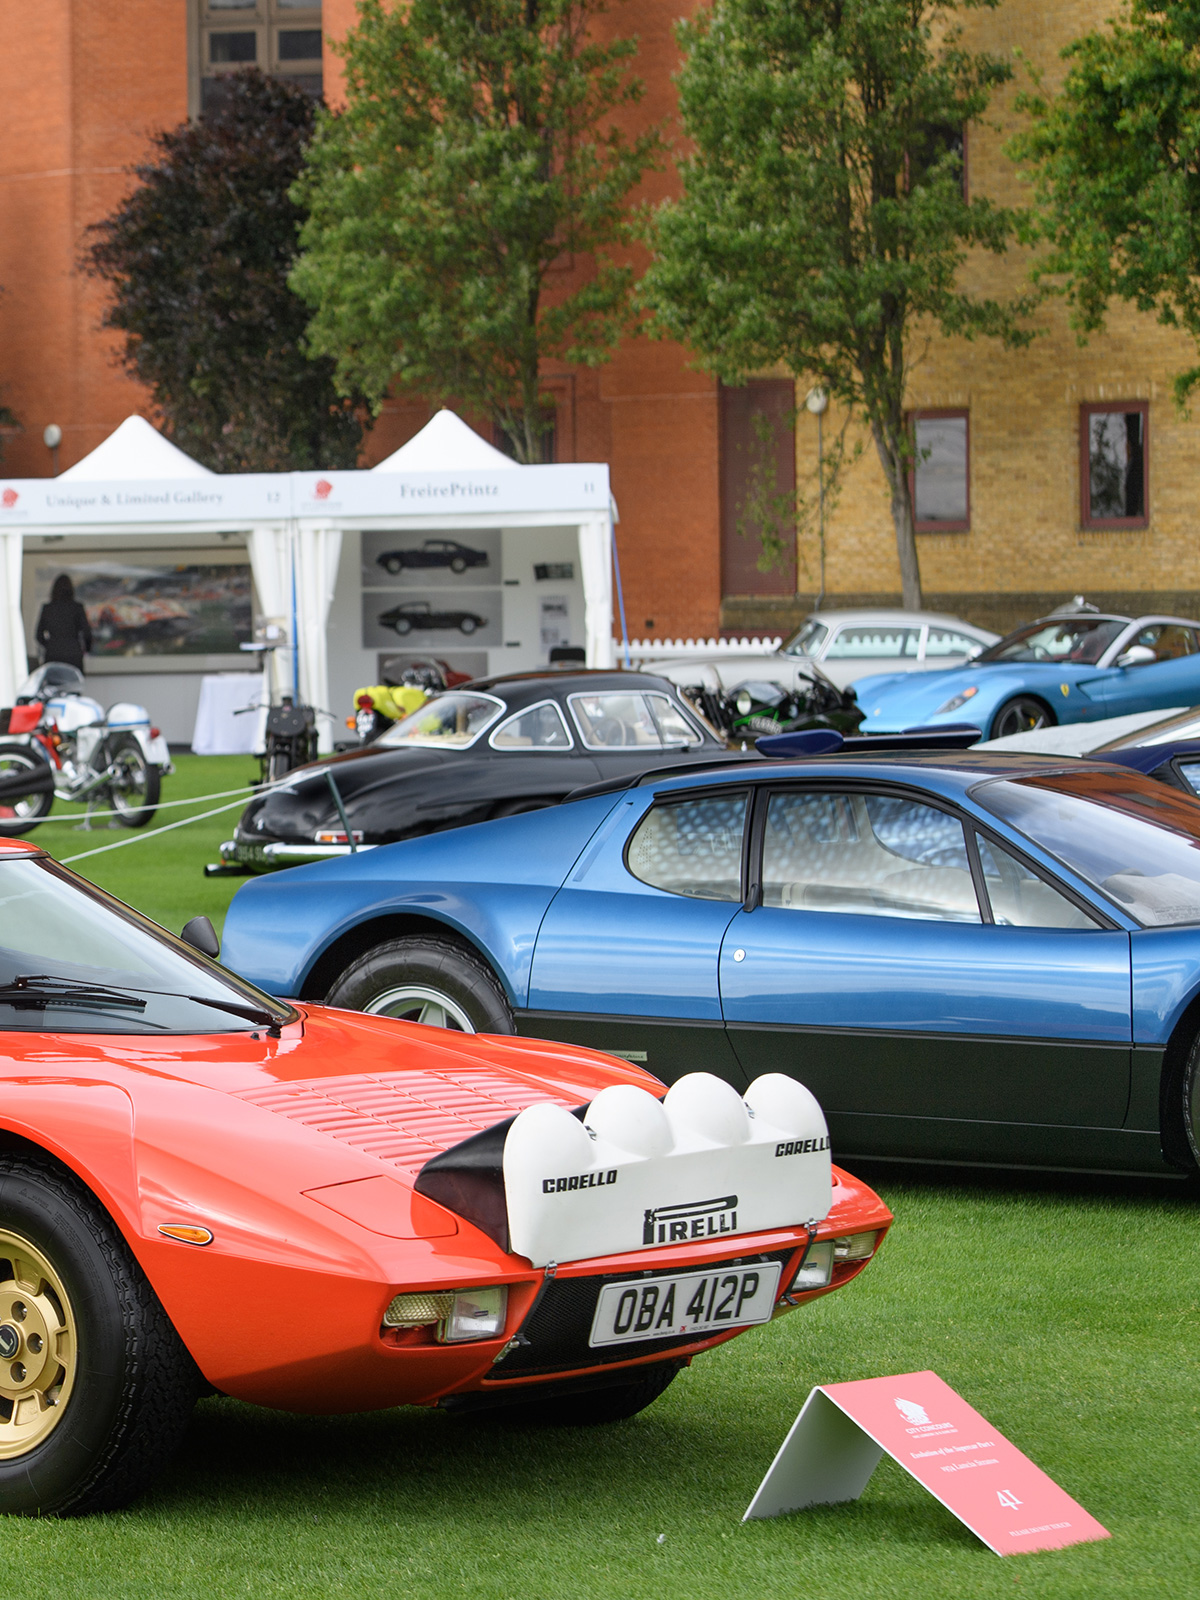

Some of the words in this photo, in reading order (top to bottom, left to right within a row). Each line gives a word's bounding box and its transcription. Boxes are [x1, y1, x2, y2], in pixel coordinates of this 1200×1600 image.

[46, 494, 96, 509] Unique
[116, 491, 170, 506] Limited
[173, 490, 223, 506] Gallery
[400, 482, 499, 498] FreirePrintz
[542, 1169, 618, 1194] CARELLO
[642, 1195, 738, 1245] PIRELLI
[613, 1282, 676, 1335] OBA
[685, 1272, 759, 1324] 412P
[920, 1422, 954, 1433] CONCOURS
[952, 1461, 977, 1471] Lancia
[996, 1489, 1024, 1511] 41
